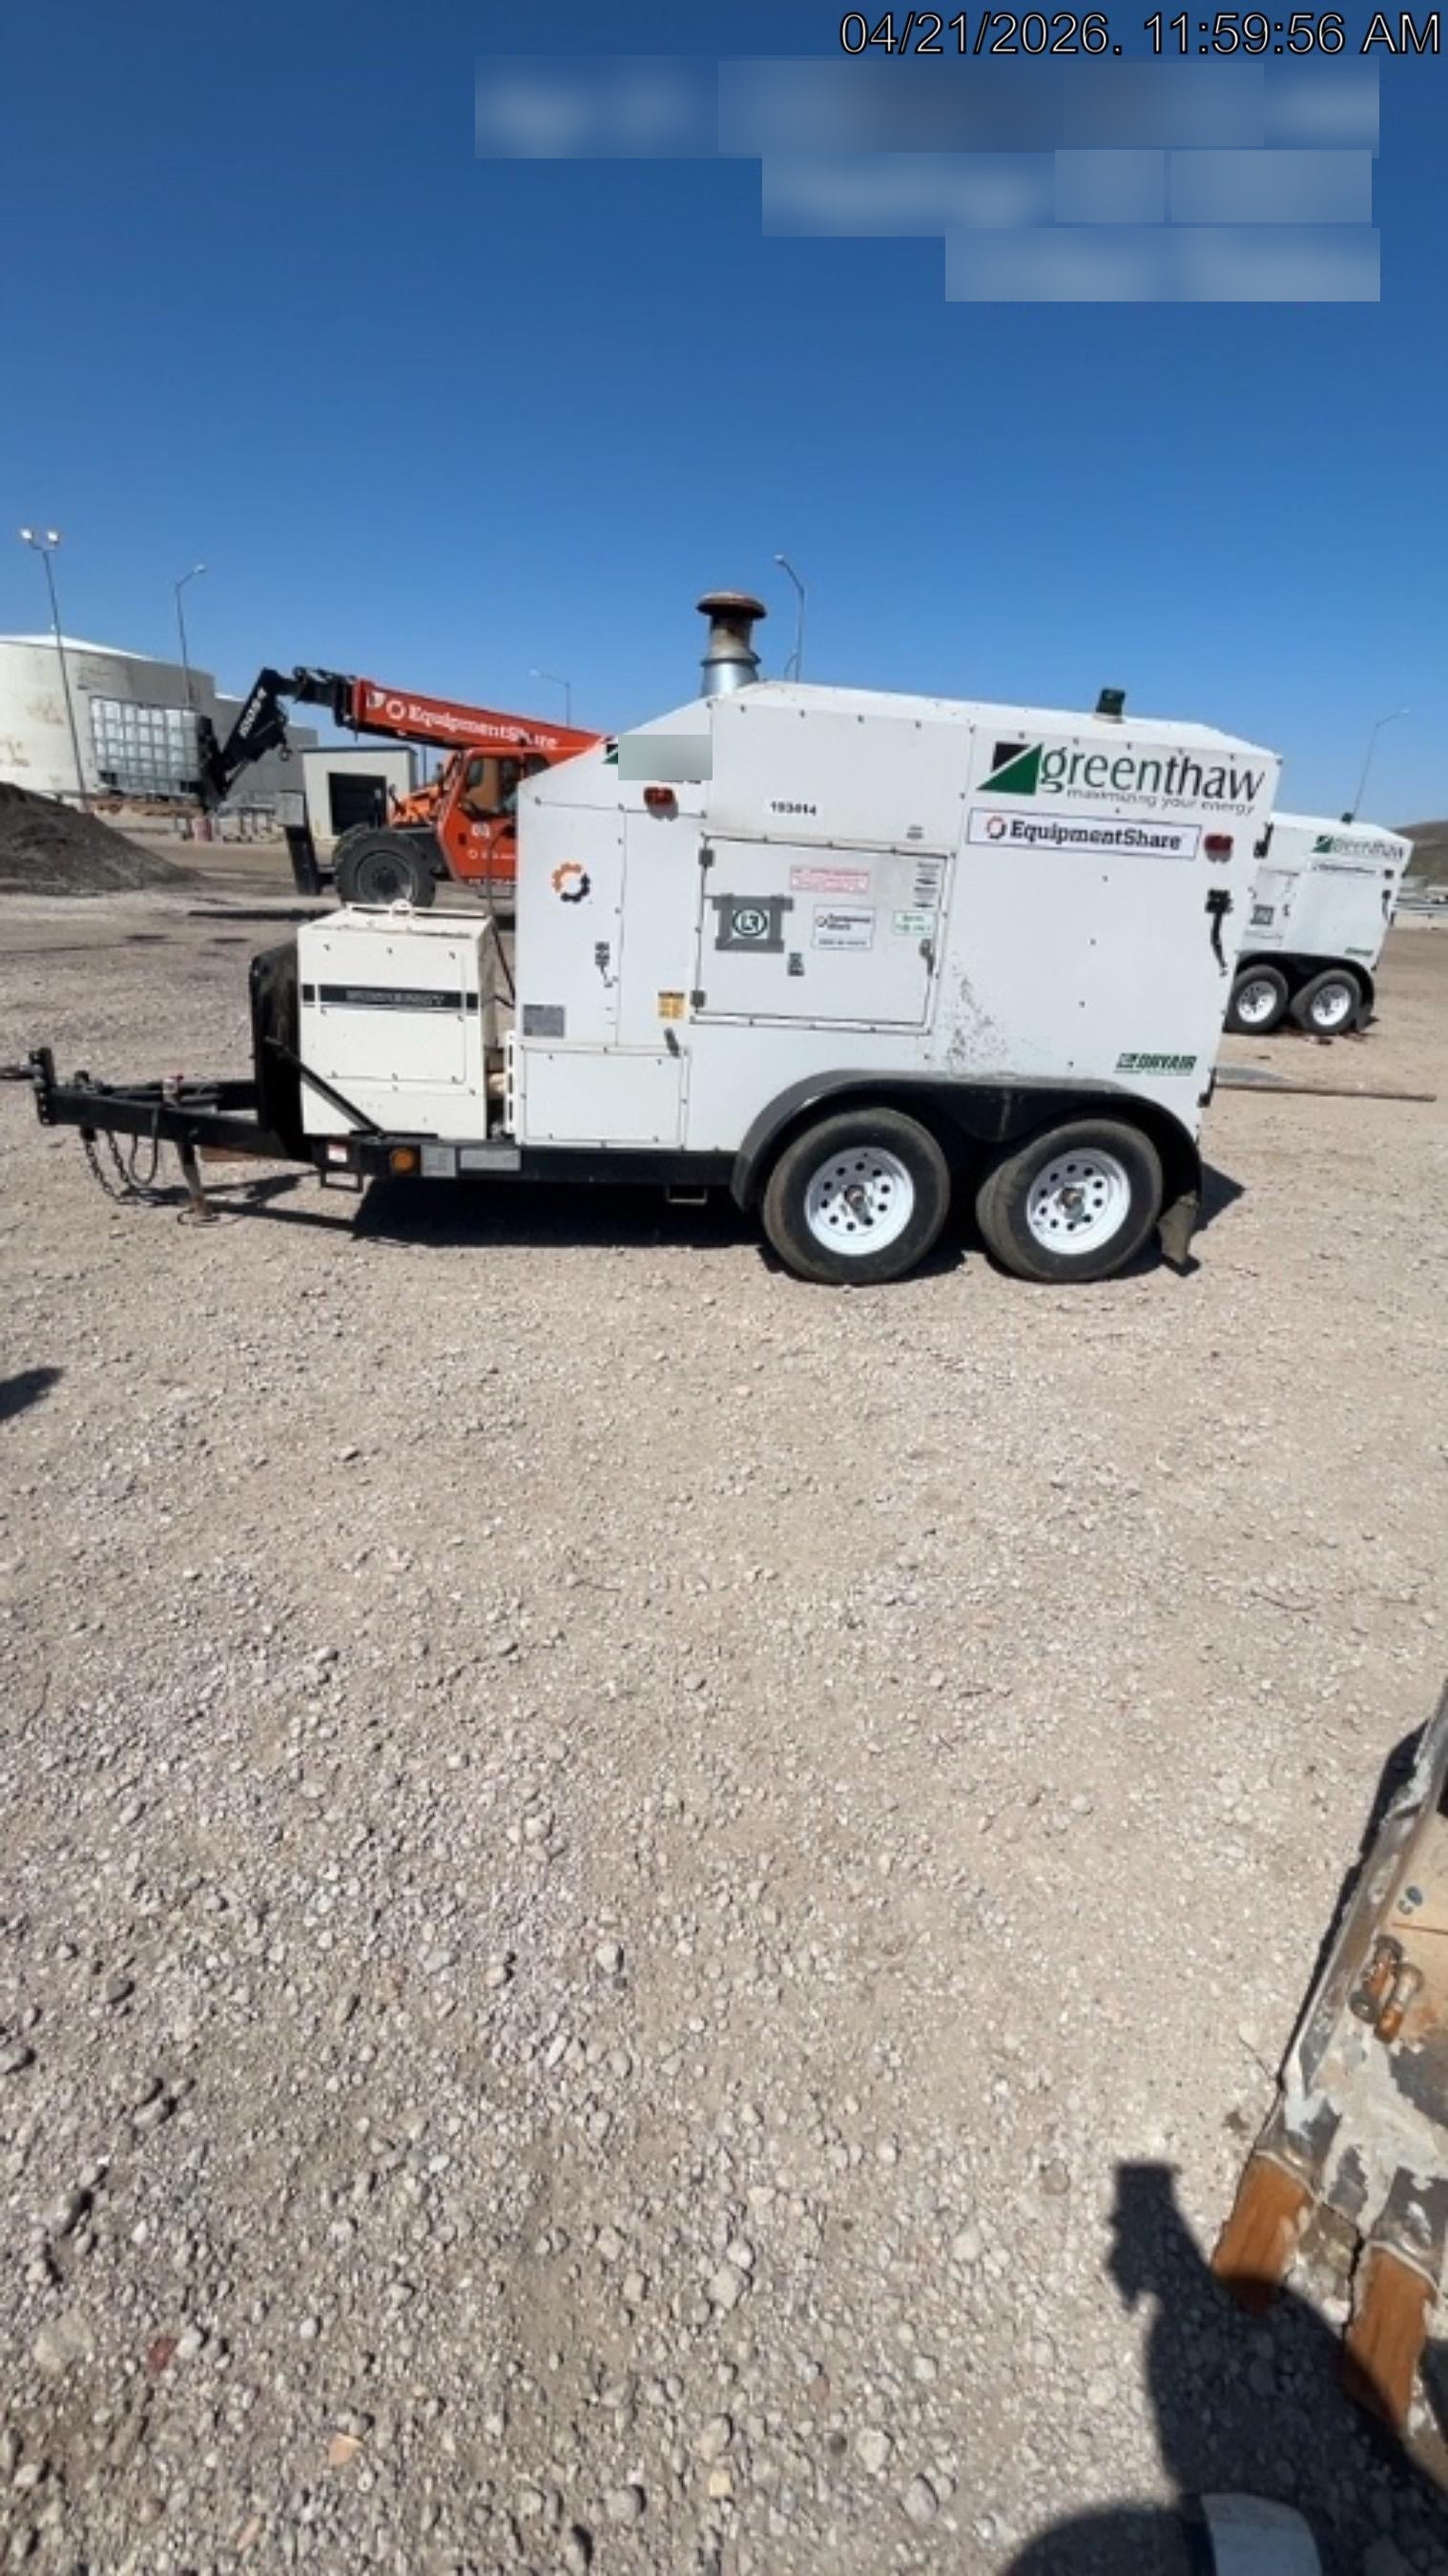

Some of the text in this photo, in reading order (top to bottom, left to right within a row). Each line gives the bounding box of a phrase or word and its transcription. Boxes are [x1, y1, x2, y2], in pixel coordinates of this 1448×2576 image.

[1041, 747, 1265, 801] greenthaw
[1161, 794, 1198, 810] your
[1201, 800, 1254, 816] energy
[1010, 821, 1181, 849] EquipmentShare
